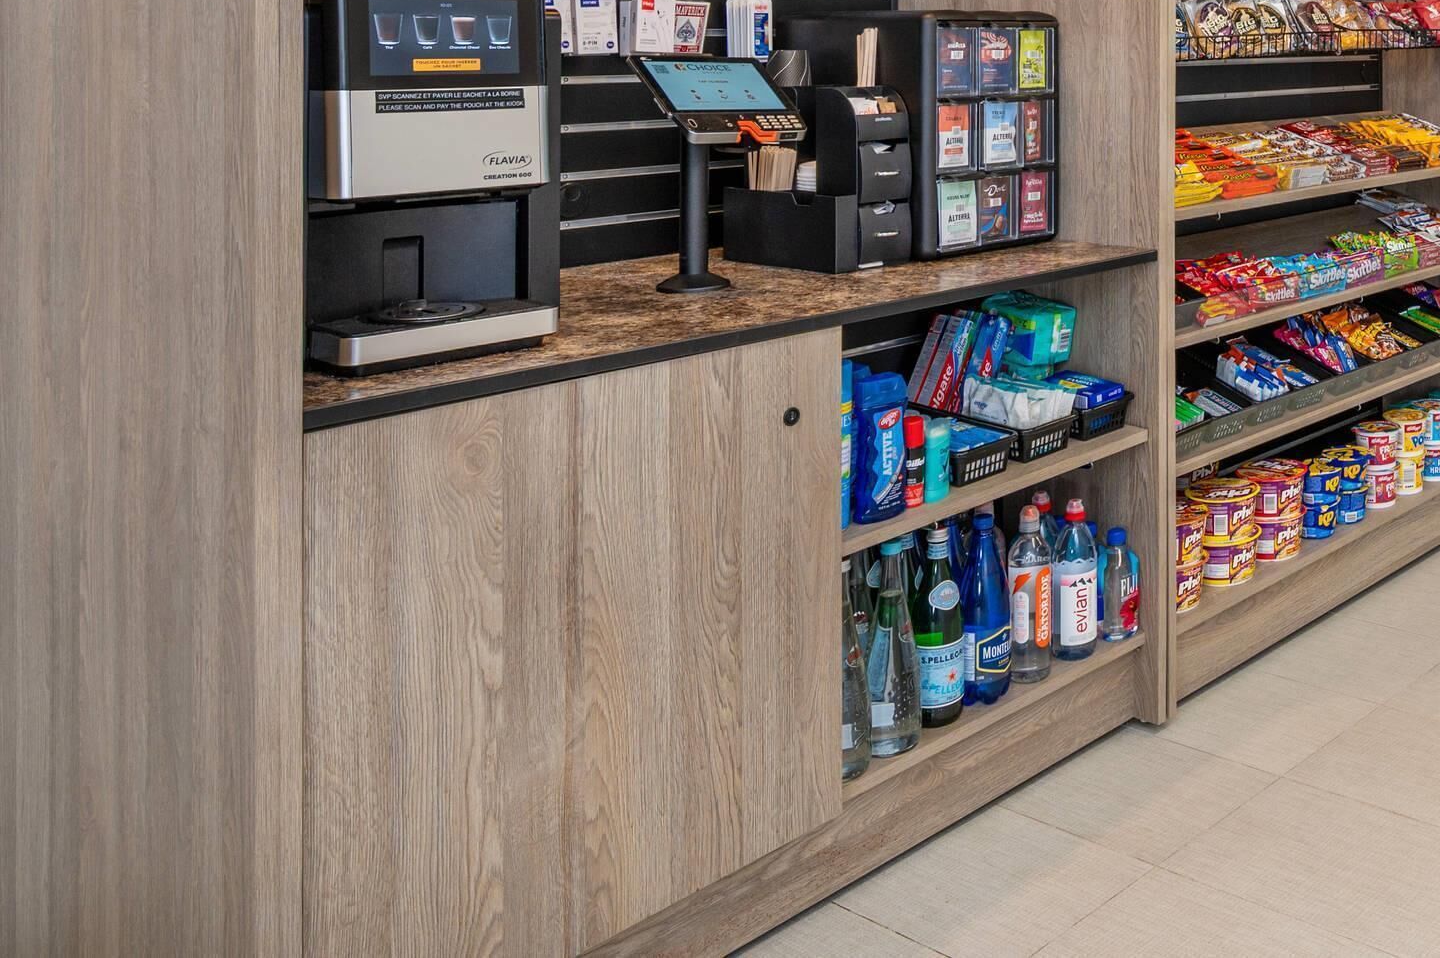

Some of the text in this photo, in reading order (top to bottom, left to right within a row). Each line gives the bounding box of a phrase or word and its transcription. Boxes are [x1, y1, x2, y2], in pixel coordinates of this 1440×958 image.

[675, 4, 705, 17] MAVERICK
[686, 63, 729, 72] CHOICE
[490, 155, 526, 166] FLAVIA
[1310, 267, 1346, 288] Skittles
[1346, 257, 1382, 283] Skittles
[1264, 287, 1295, 301] Skittles
[932, 364, 954, 410] lgate
[882, 430, 893, 476] ACTIVE
[1041, 574, 1049, 639] GATORADE
[1074, 587, 1087, 633] evian
